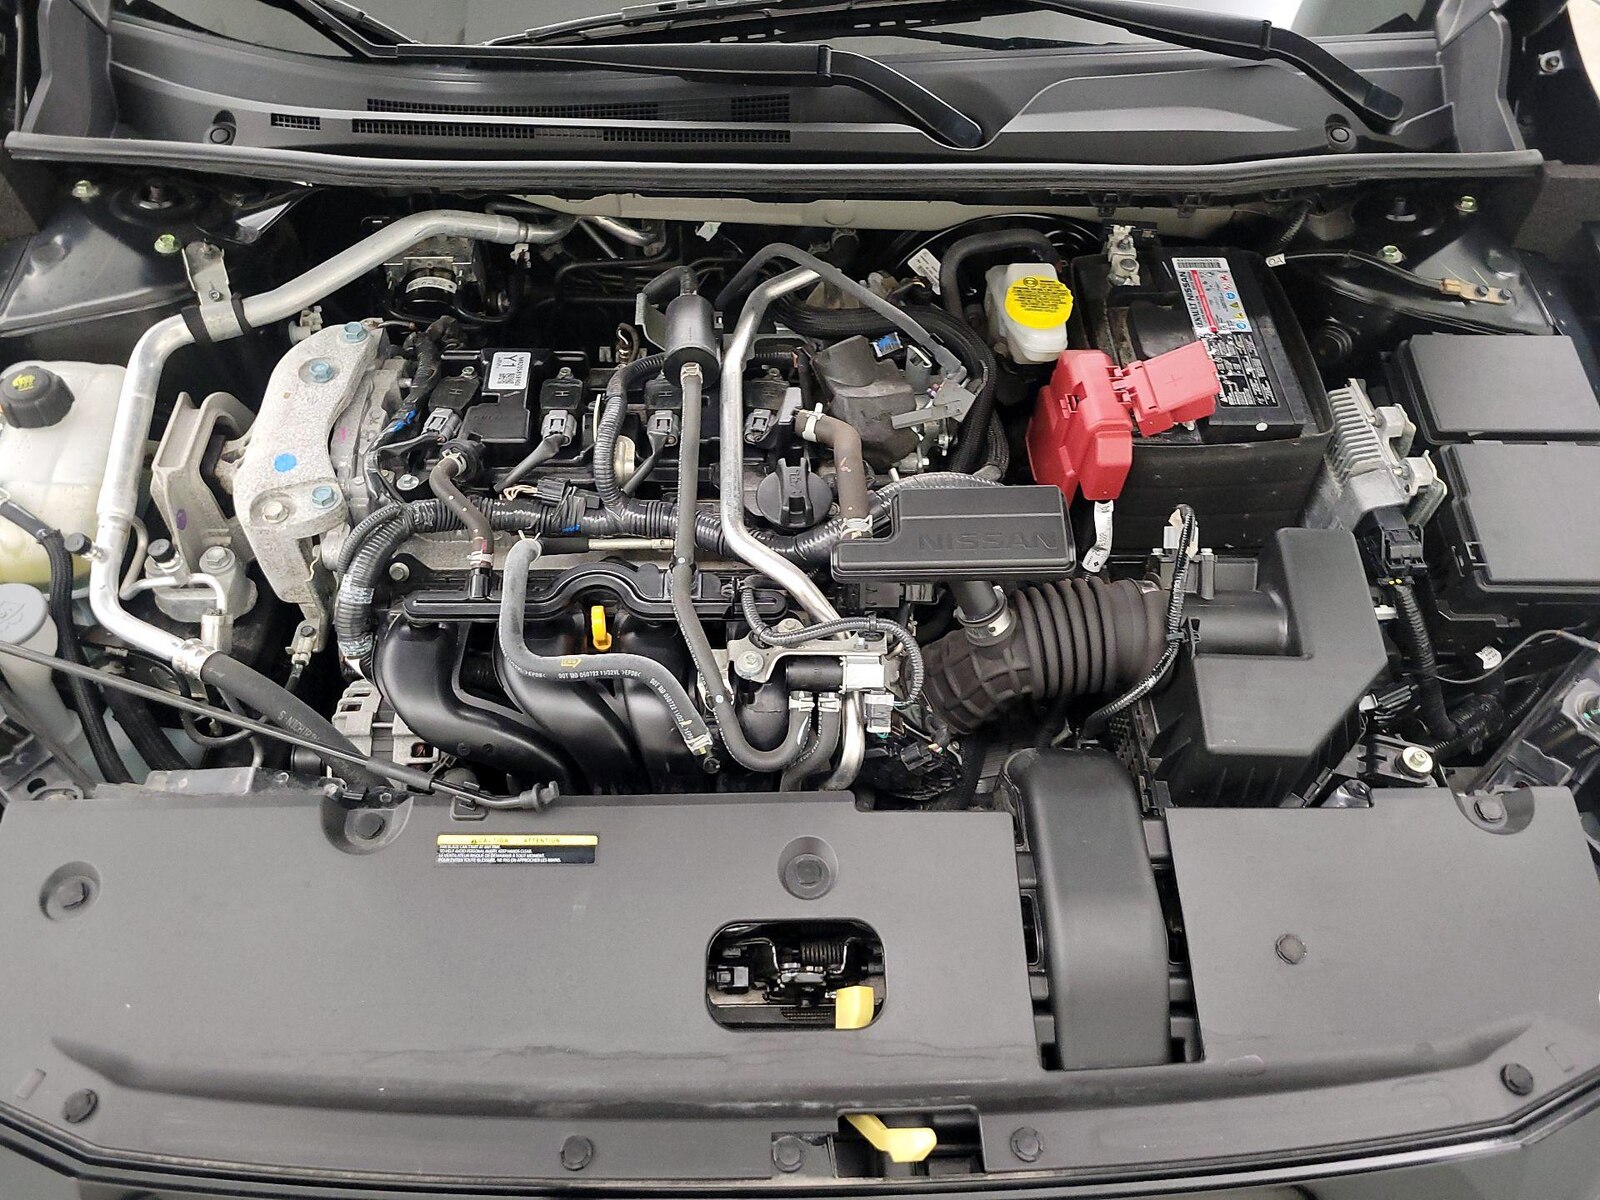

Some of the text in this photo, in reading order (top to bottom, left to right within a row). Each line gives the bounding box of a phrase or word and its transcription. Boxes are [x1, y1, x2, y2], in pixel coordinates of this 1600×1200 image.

[1178, 271, 1194, 301] NISSAN
[502, 354, 518, 367] Y1
[918, 531, 1058, 552] NISSAN
